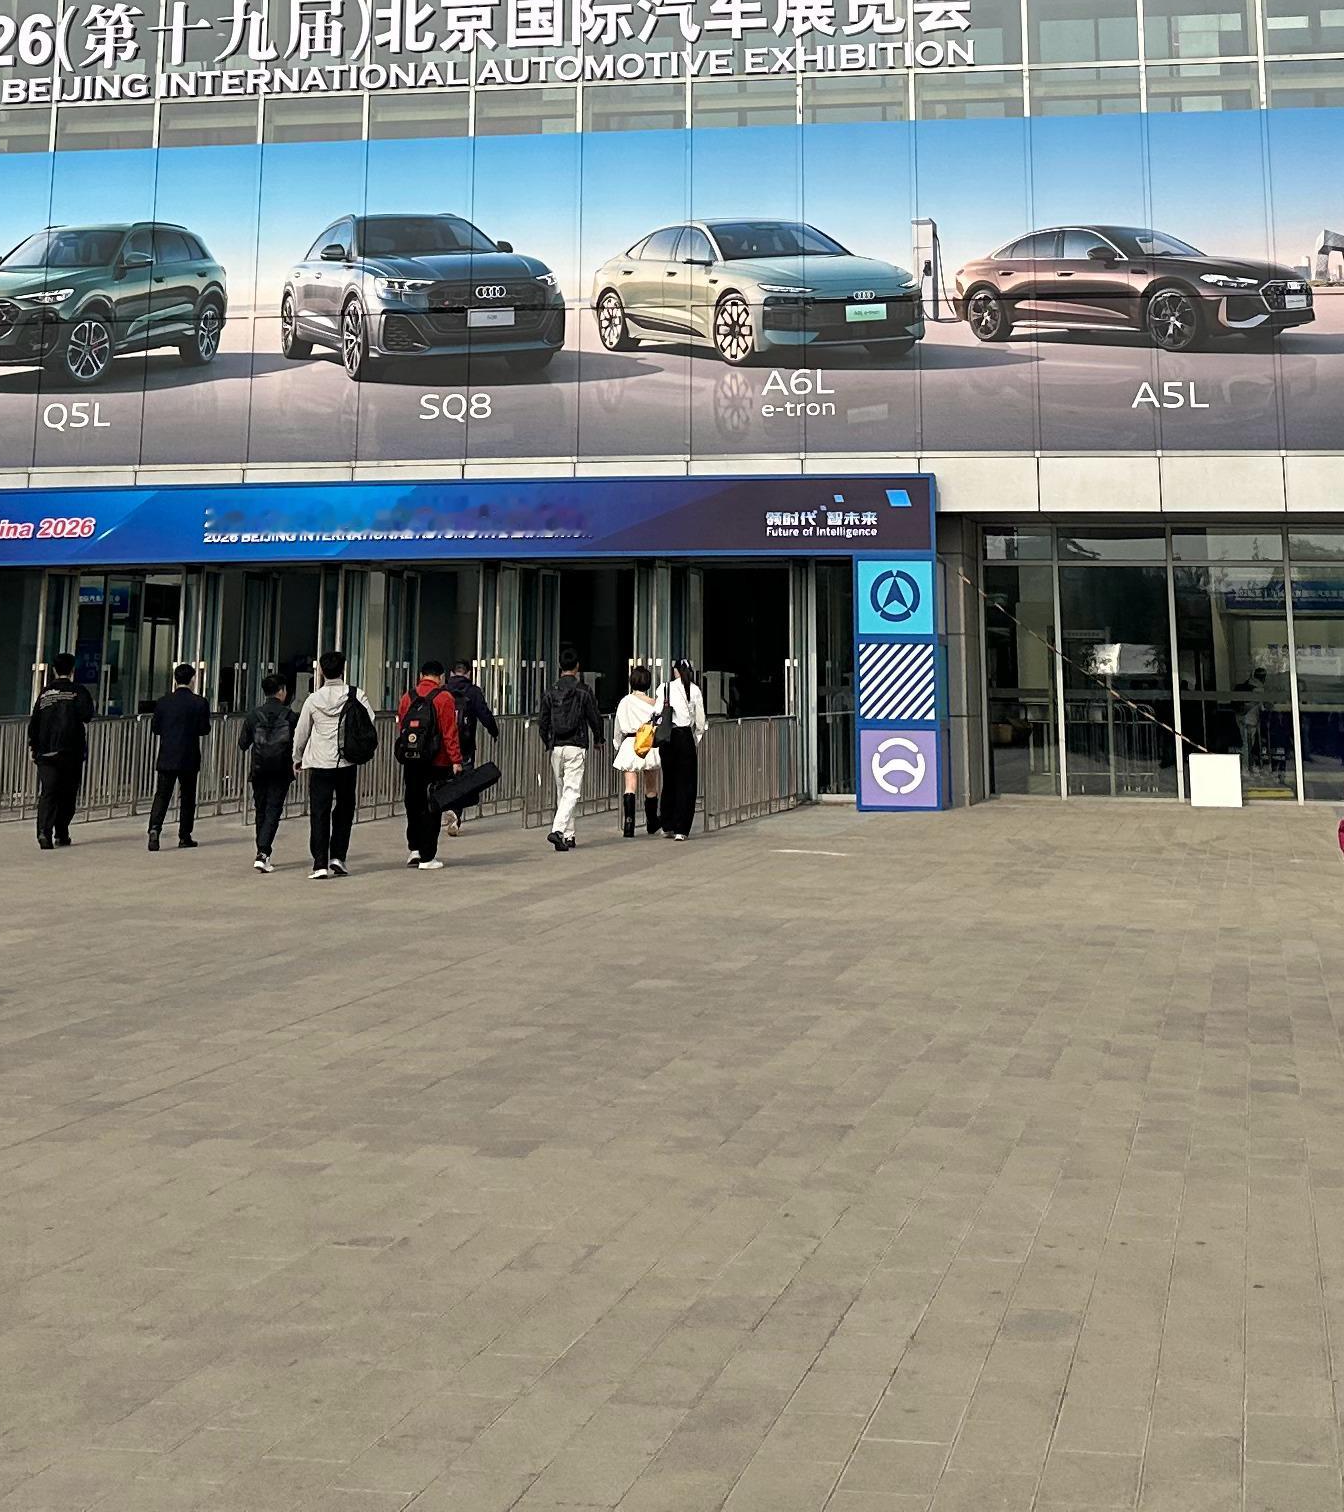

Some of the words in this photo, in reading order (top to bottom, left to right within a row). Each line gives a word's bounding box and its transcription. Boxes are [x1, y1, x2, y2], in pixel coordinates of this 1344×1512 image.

[0, 72, 151, 104] BEIJING
[158, 60, 470, 99] INTERNATIONAL
[476, 48, 735, 85] AUTOMOTIVE
[744, 39, 975, 74] EXHIBITION
[761, 368, 835, 396] A6L
[1132, 381, 1210, 409] A5L
[43, 402, 111, 431] Q5L
[419, 394, 493, 421] SQ8
[761, 401, 836, 417] e-tron
[36, 517, 96, 539] 2026
[766, 527, 800, 537] Future
[802, 527, 814, 537] of
[816, 527, 878, 538] Intelligence
